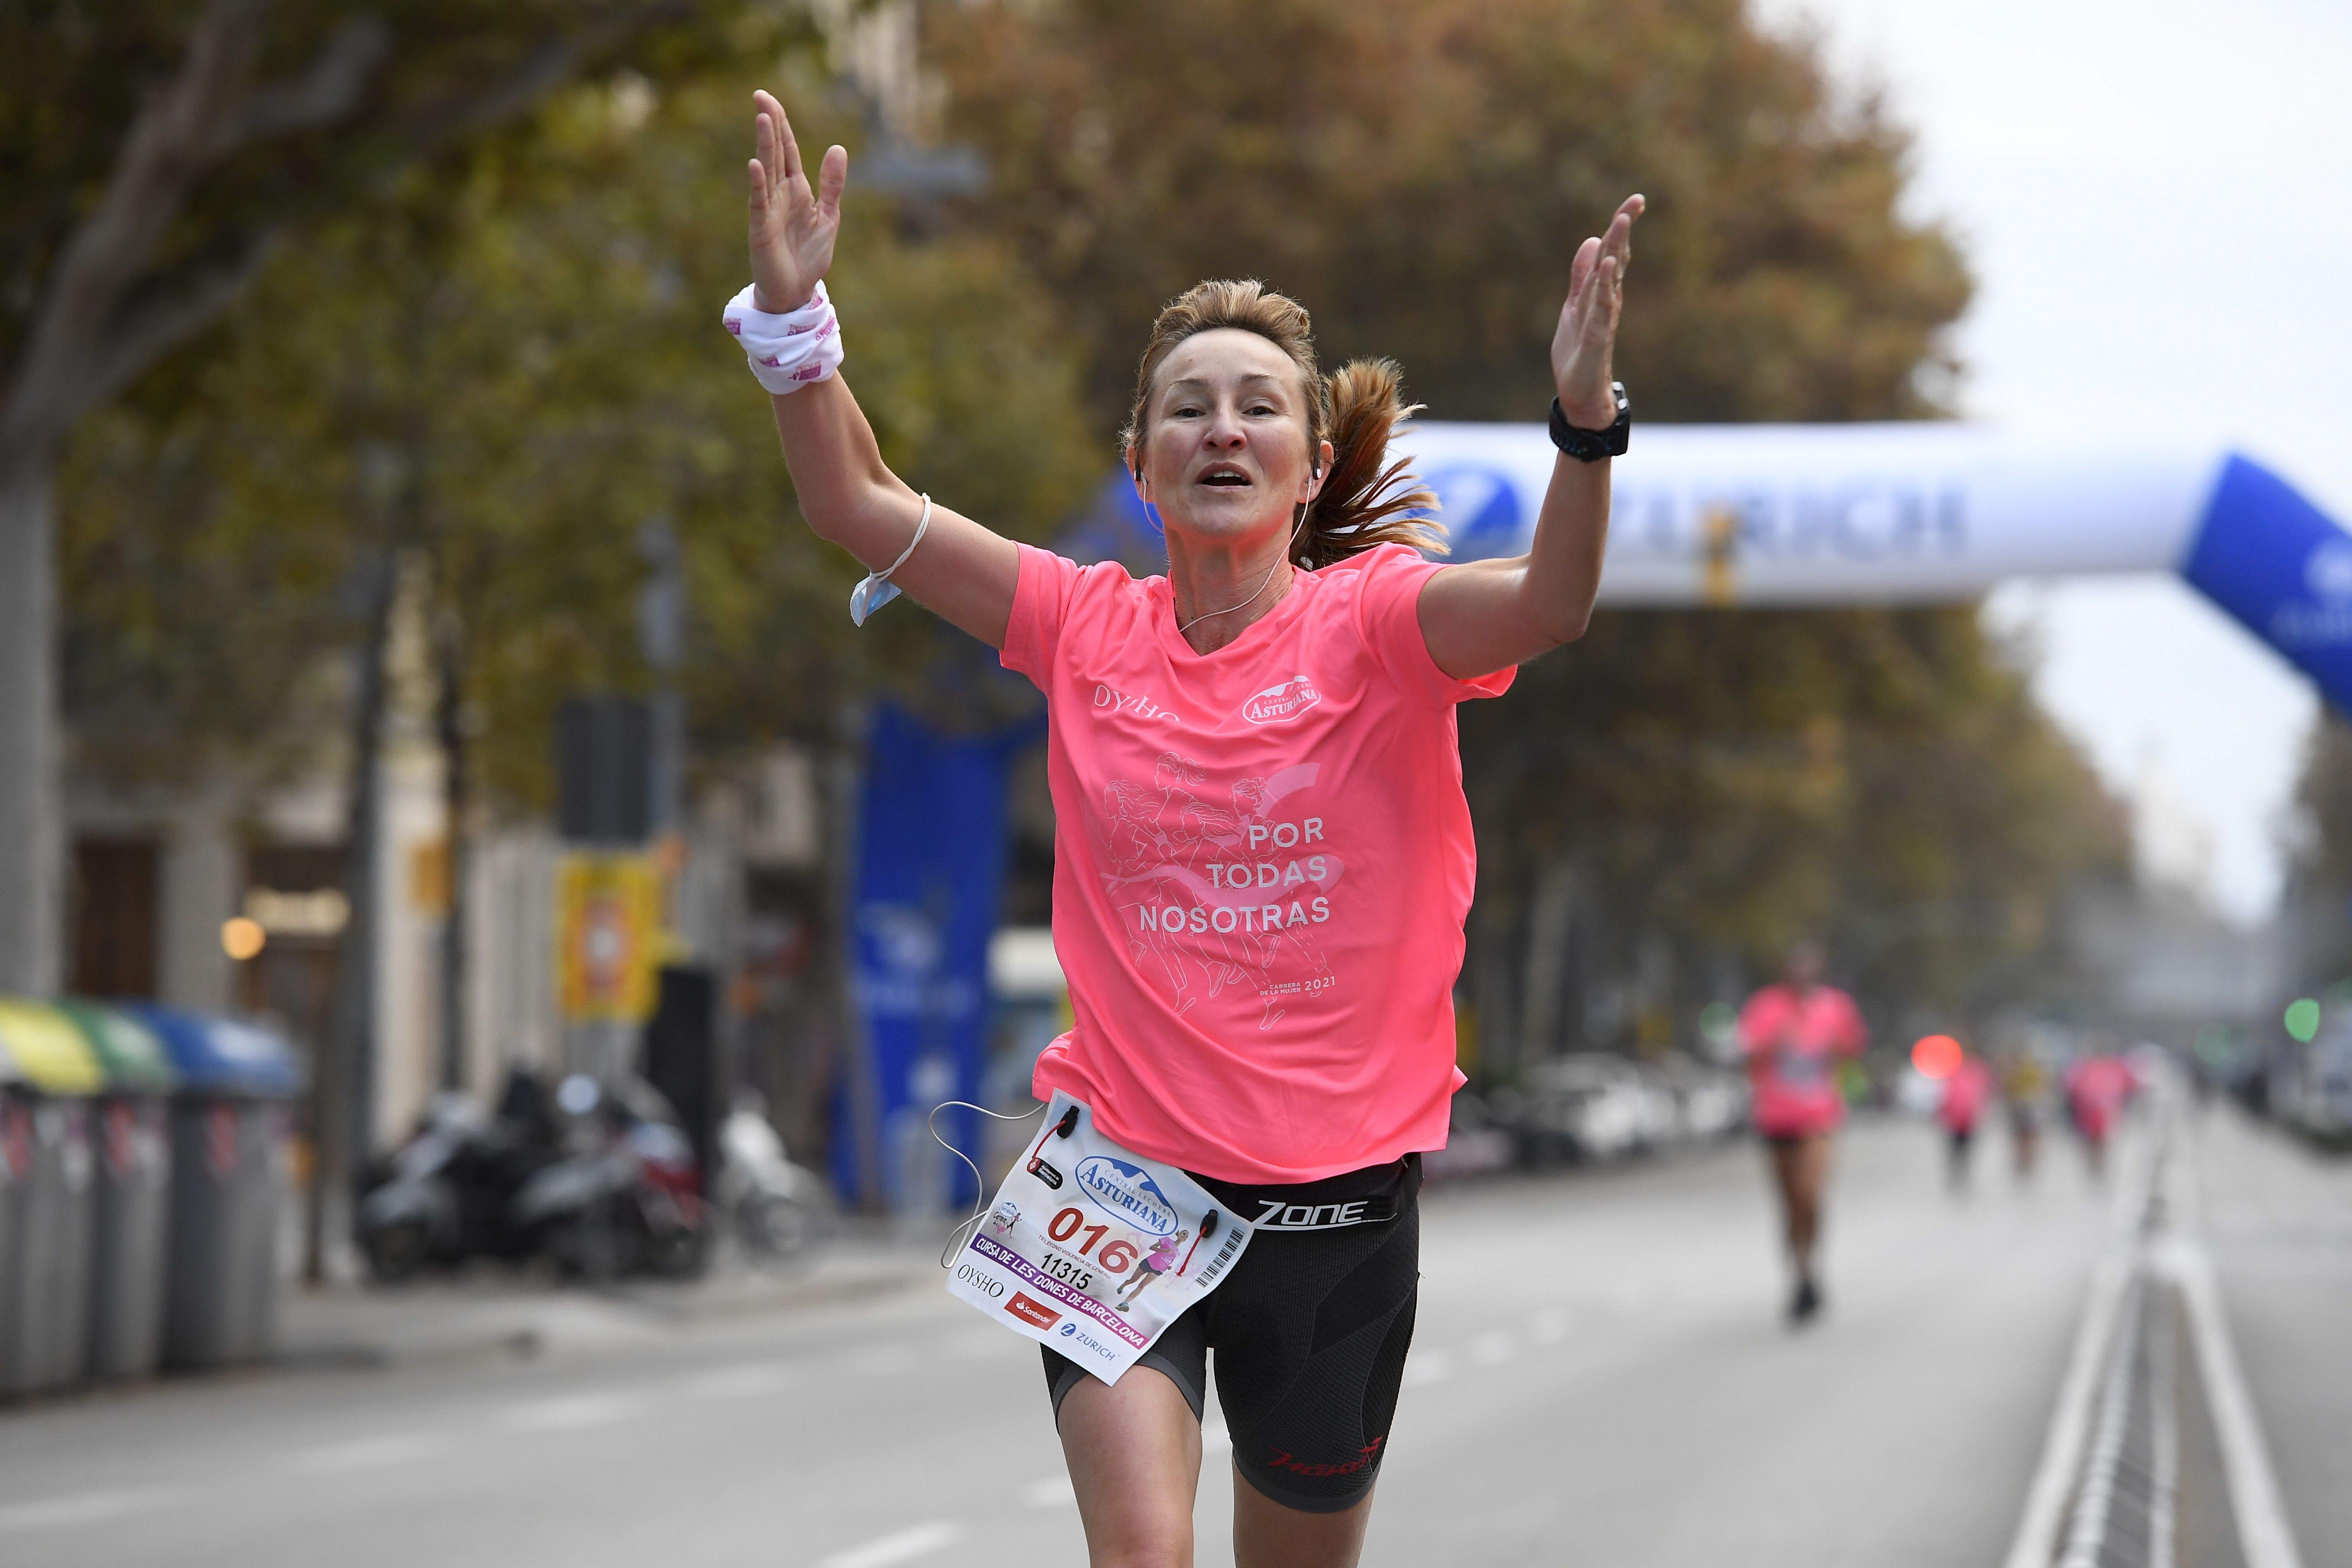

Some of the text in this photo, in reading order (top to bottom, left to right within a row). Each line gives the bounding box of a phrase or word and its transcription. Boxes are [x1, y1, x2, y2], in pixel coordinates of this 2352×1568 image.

[1094, 684, 1180, 722] OYH
[1250, 689, 1318, 719] ASTURIANA
[1249, 817, 1324, 850] POR
[1206, 855, 1328, 889] TODAS
[1140, 896, 1330, 933] NOSOTRAS
[1304, 976, 1336, 991] 2021
[1038, 1167, 1057, 1185] Barcelona
[1105, 1170, 1171, 1217] CENTRAL LECHERA
[1080, 1163, 1168, 1233] ASTURIANA
[1038, 1234, 1062, 1252] TELÉFONO
[1062, 1249, 1085, 1265] VIOLENCIA
[1092, 1265, 1112, 1280] GÉNERO
[1047, 1207, 1138, 1274] 016
[957, 1264, 1004, 1298] OYSHO
[1040, 1253, 1093, 1290] 11315
[976, 1238, 1145, 1347] CURSA DE LES DONES DE BARCELONA
[1023, 1306, 1051, 1323] Santander
[1076, 1332, 1116, 1361] ZURICH
